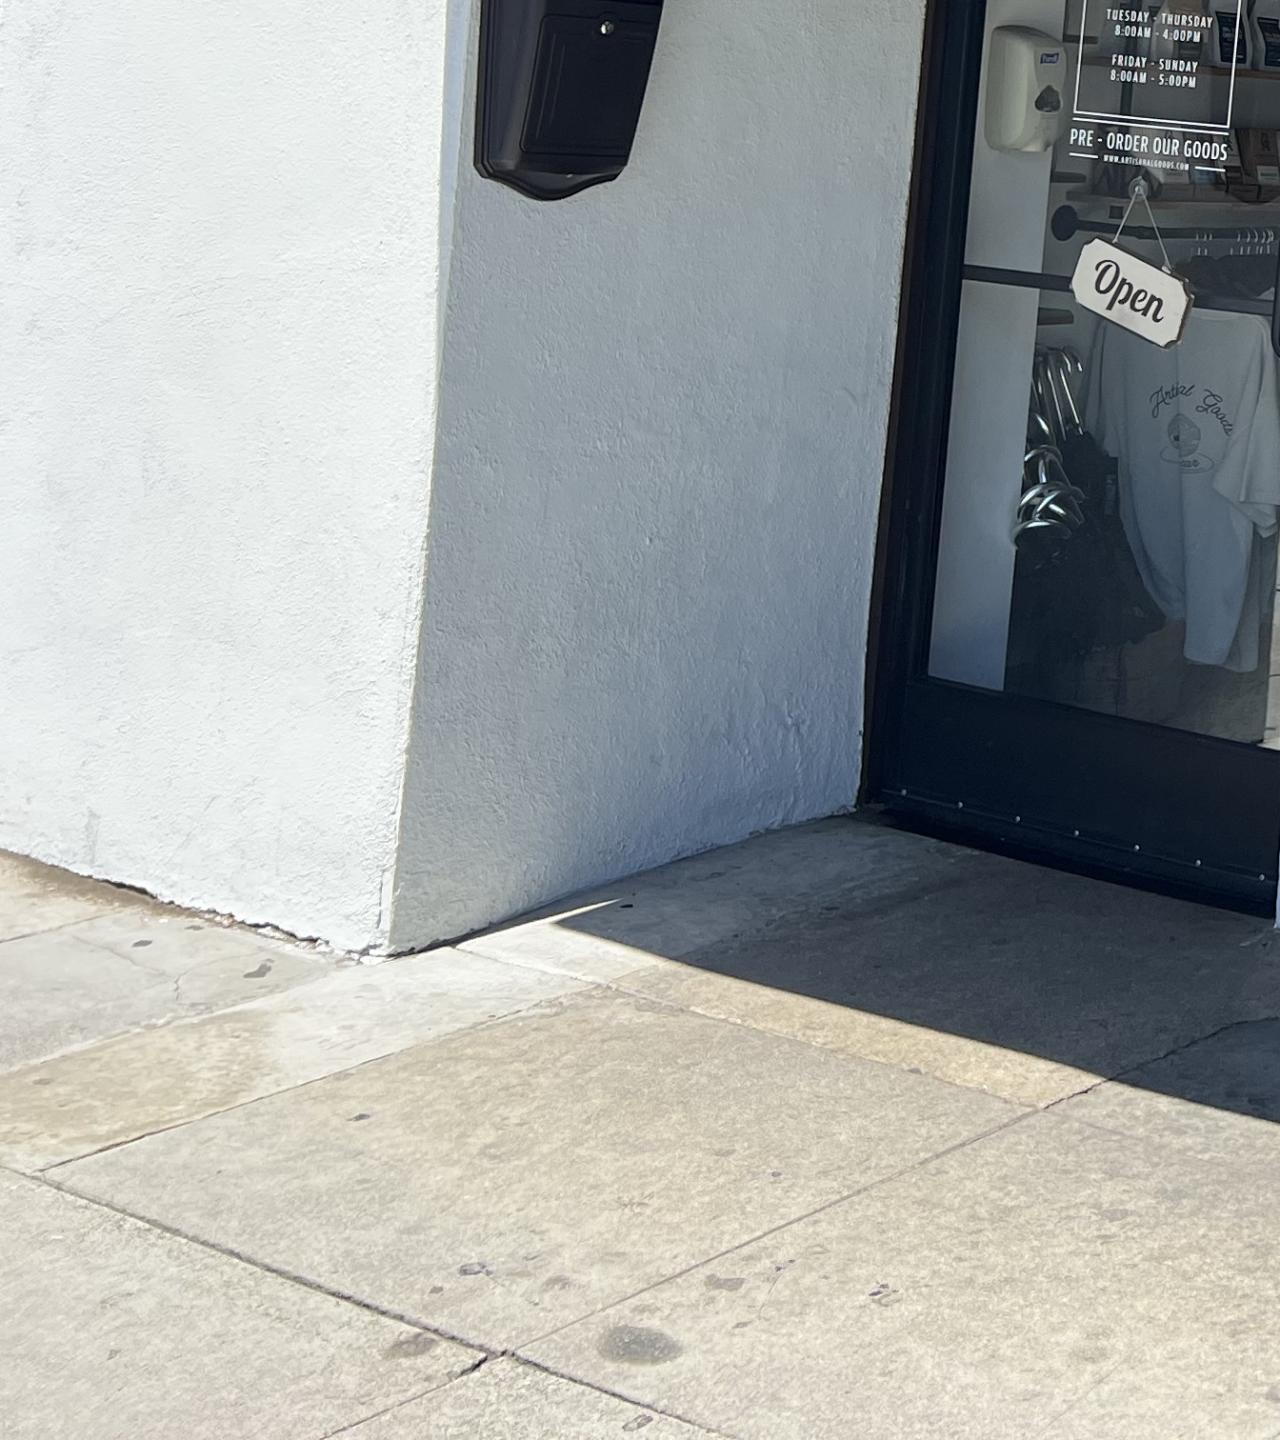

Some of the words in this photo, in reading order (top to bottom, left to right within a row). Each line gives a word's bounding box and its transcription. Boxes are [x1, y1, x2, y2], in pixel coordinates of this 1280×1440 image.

[1106, 9, 1150, 23] TUESDAY
[1161, 13, 1213, 29] THURSDAY
[1114, 24, 1151, 38] 8:00AM
[1162, 30, 1201, 43] 4:00PM
[1111, 53, 1147, 68] FRIDAY
[1159, 59, 1198, 73] SUNDAY
[1110, 69, 1147, 84] 8:00AM
[1158, 73, 1196, 88] 5:00PM
[1069, 128, 1095, 147] PRE
[1106, 132, 1149, 153] ORDER
[1152, 137, 1180, 156] OUR
[1183, 140, 1228, 161] GOODS
[1094, 259, 1164, 323] Open
